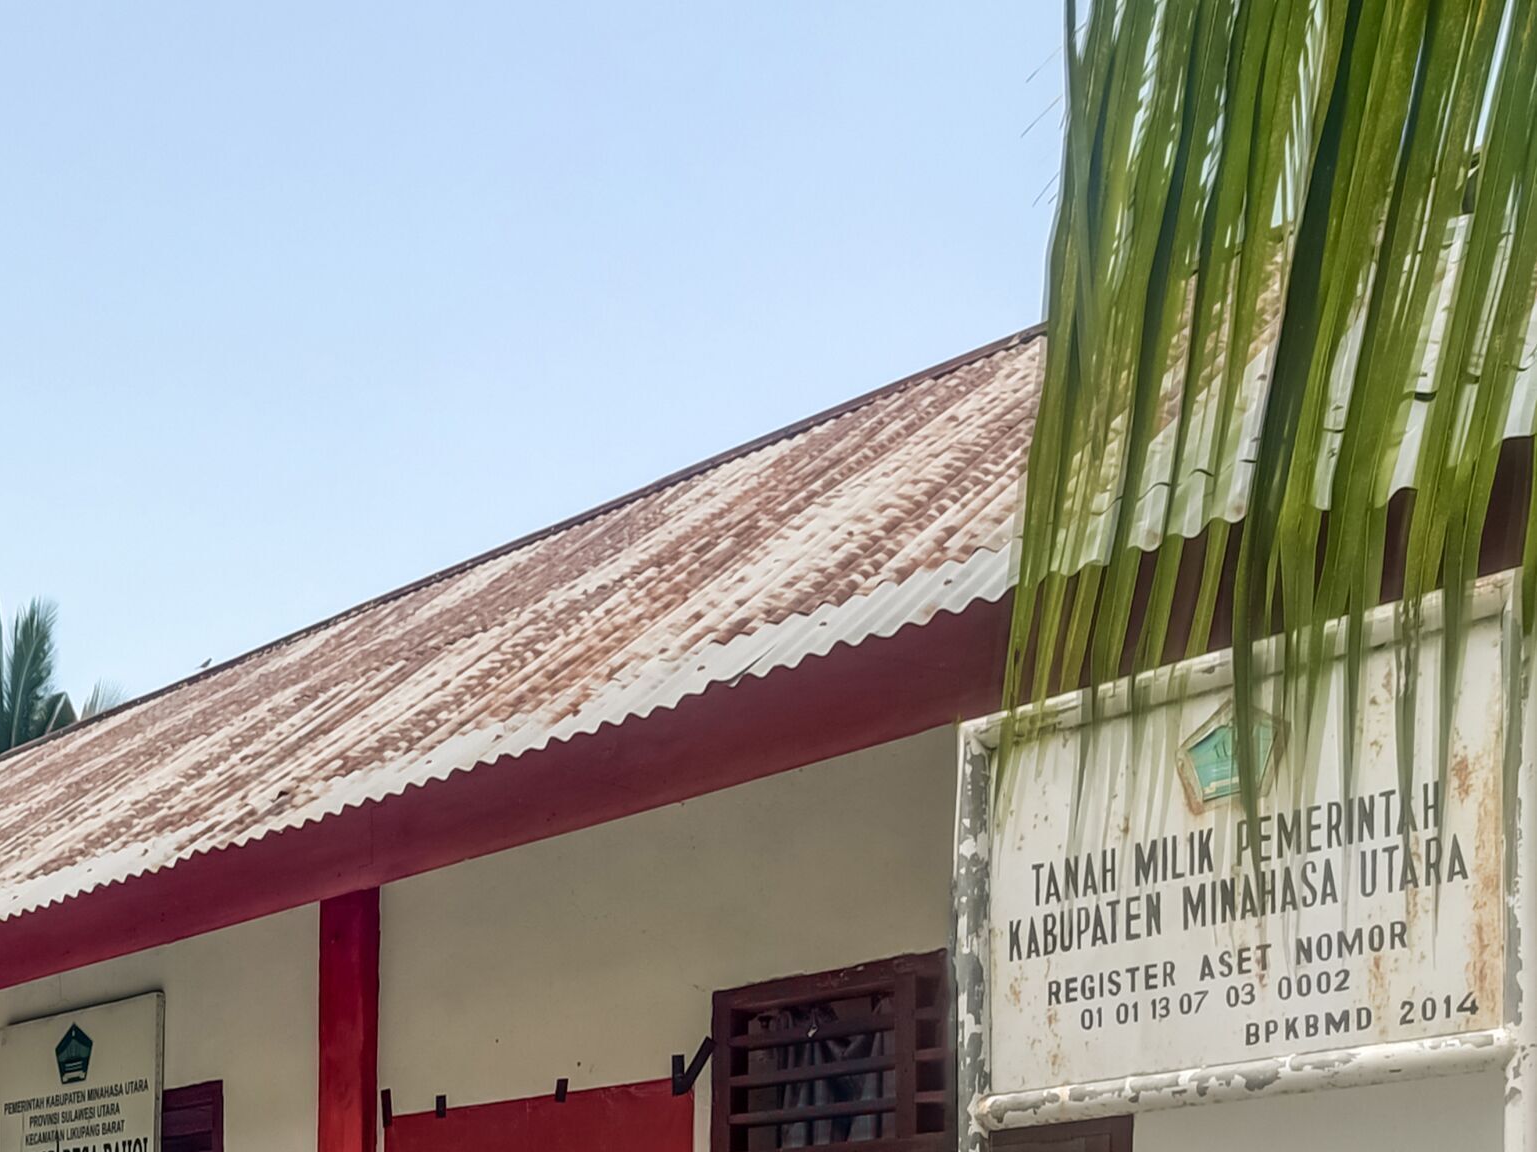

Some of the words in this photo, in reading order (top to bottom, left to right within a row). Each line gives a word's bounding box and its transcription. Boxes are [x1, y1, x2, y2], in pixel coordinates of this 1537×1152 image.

[1032, 848, 1116, 906] TANAH
[1135, 828, 1213, 887] MILIK
[1237, 781, 1439, 867] PEMERINTAH
[1009, 892, 1161, 962] KABUPATEN
[1183, 858, 1338, 930] MINAHASA
[1360, 833, 1469, 897] UTARA
[1048, 961, 1175, 1006] REGISTER
[1199, 943, 1271, 981] ASET
[1296, 921, 1407, 965] NOMOR
[1081, 1007, 1103, 1030] 01
[1116, 1001, 1139, 1024] 01
[1151, 997, 1170, 1020] 13
[1179, 990, 1209, 1015] 07
[1226, 983, 1256, 1007] 03
[1278, 969, 1350, 1000] 0002
[1245, 1006, 1373, 1046] BPKBMD
[1399, 991, 1480, 1025] 2014
[4, 1098, 45, 1115] PEMERINTAH
[46, 1090, 86, 1108] KABUPATEN
[87, 1084, 124, 1101] MINAHASA
[125, 1078, 149, 1095] UTARA
[29, 1112, 60, 1128] PROVINSI
[61, 1106, 96, 1124] SULAWESI
[97, 1103, 121, 1118] UTARA
[25, 1129, 65, 1146] KECAMATAN
[66, 1124, 100, 1141] LIKUPANG
[102, 1119, 125, 1135] BARAT
